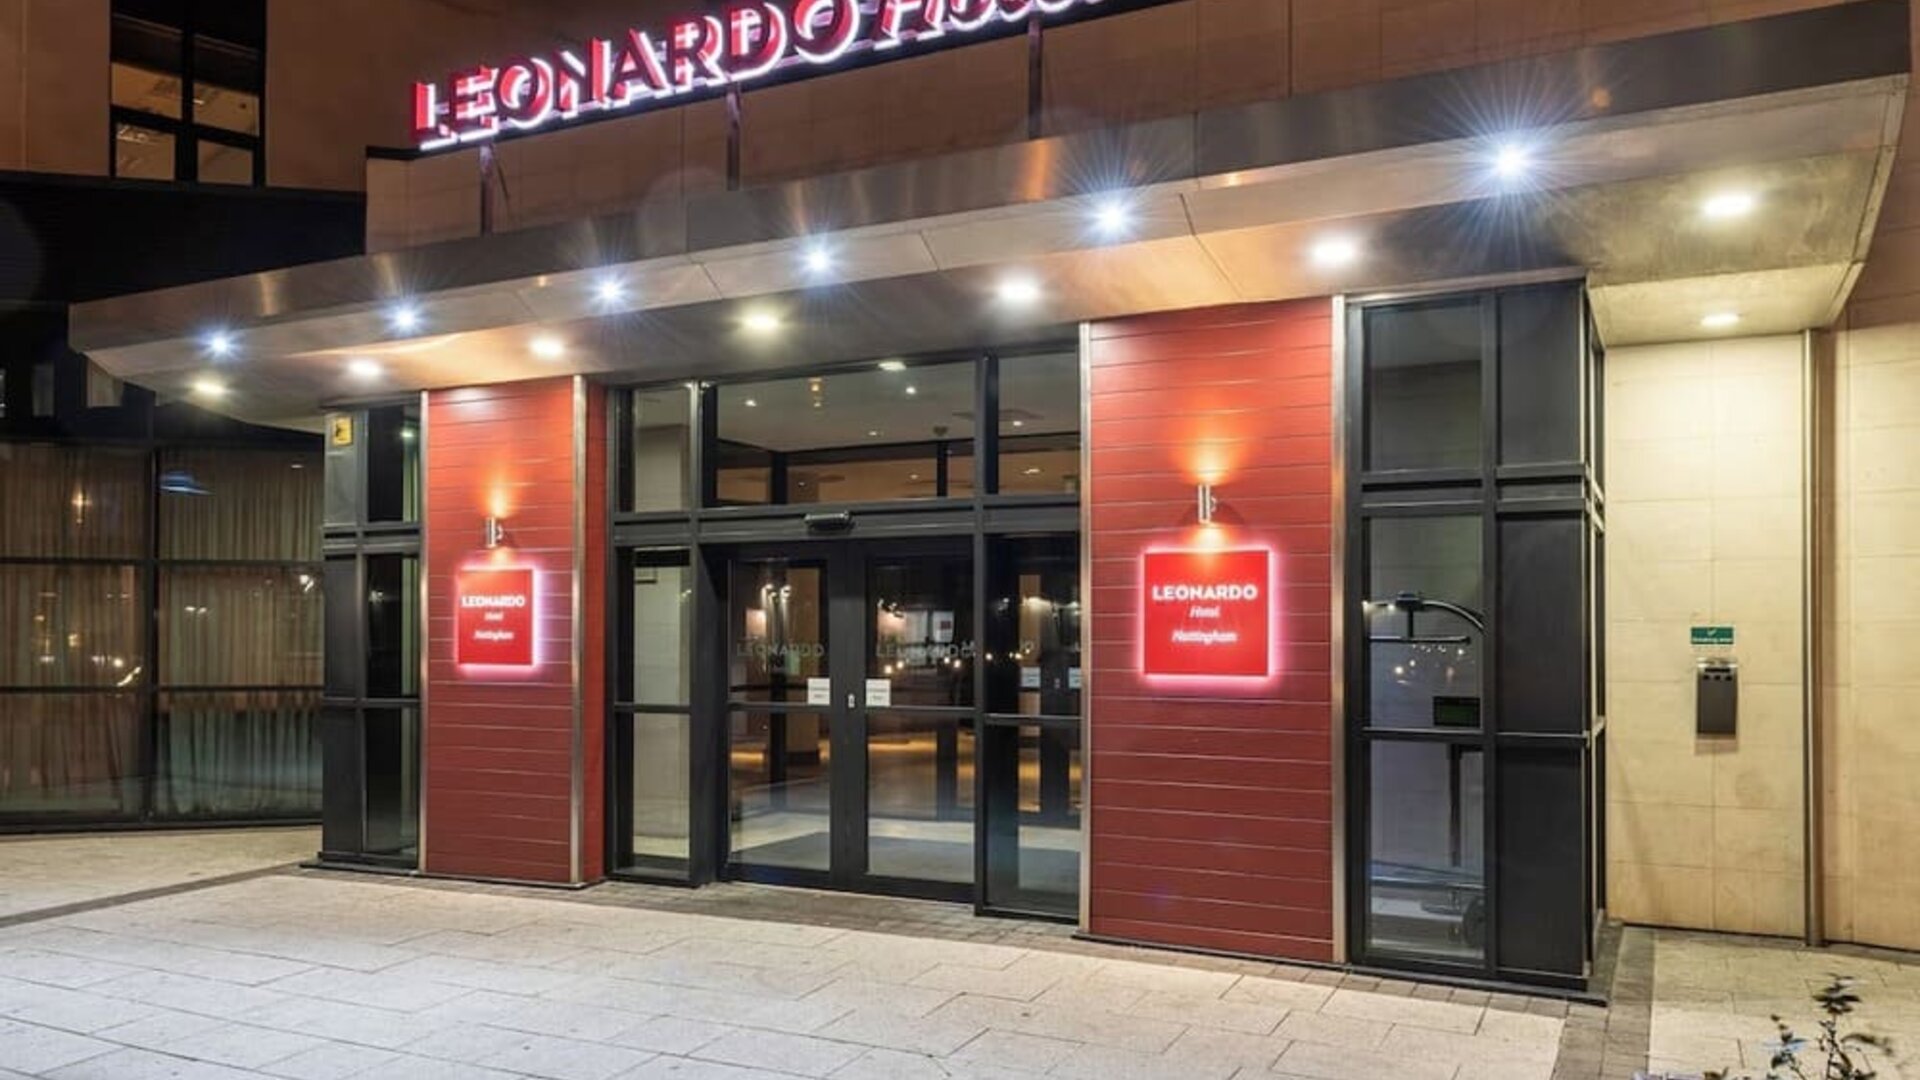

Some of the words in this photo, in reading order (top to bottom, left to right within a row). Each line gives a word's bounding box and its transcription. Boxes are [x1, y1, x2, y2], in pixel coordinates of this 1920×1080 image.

[411, 0, 860, 150] LEONARDO
[461, 594, 526, 608] LEONARDO
[1151, 583, 1258, 601] LEONARDO
